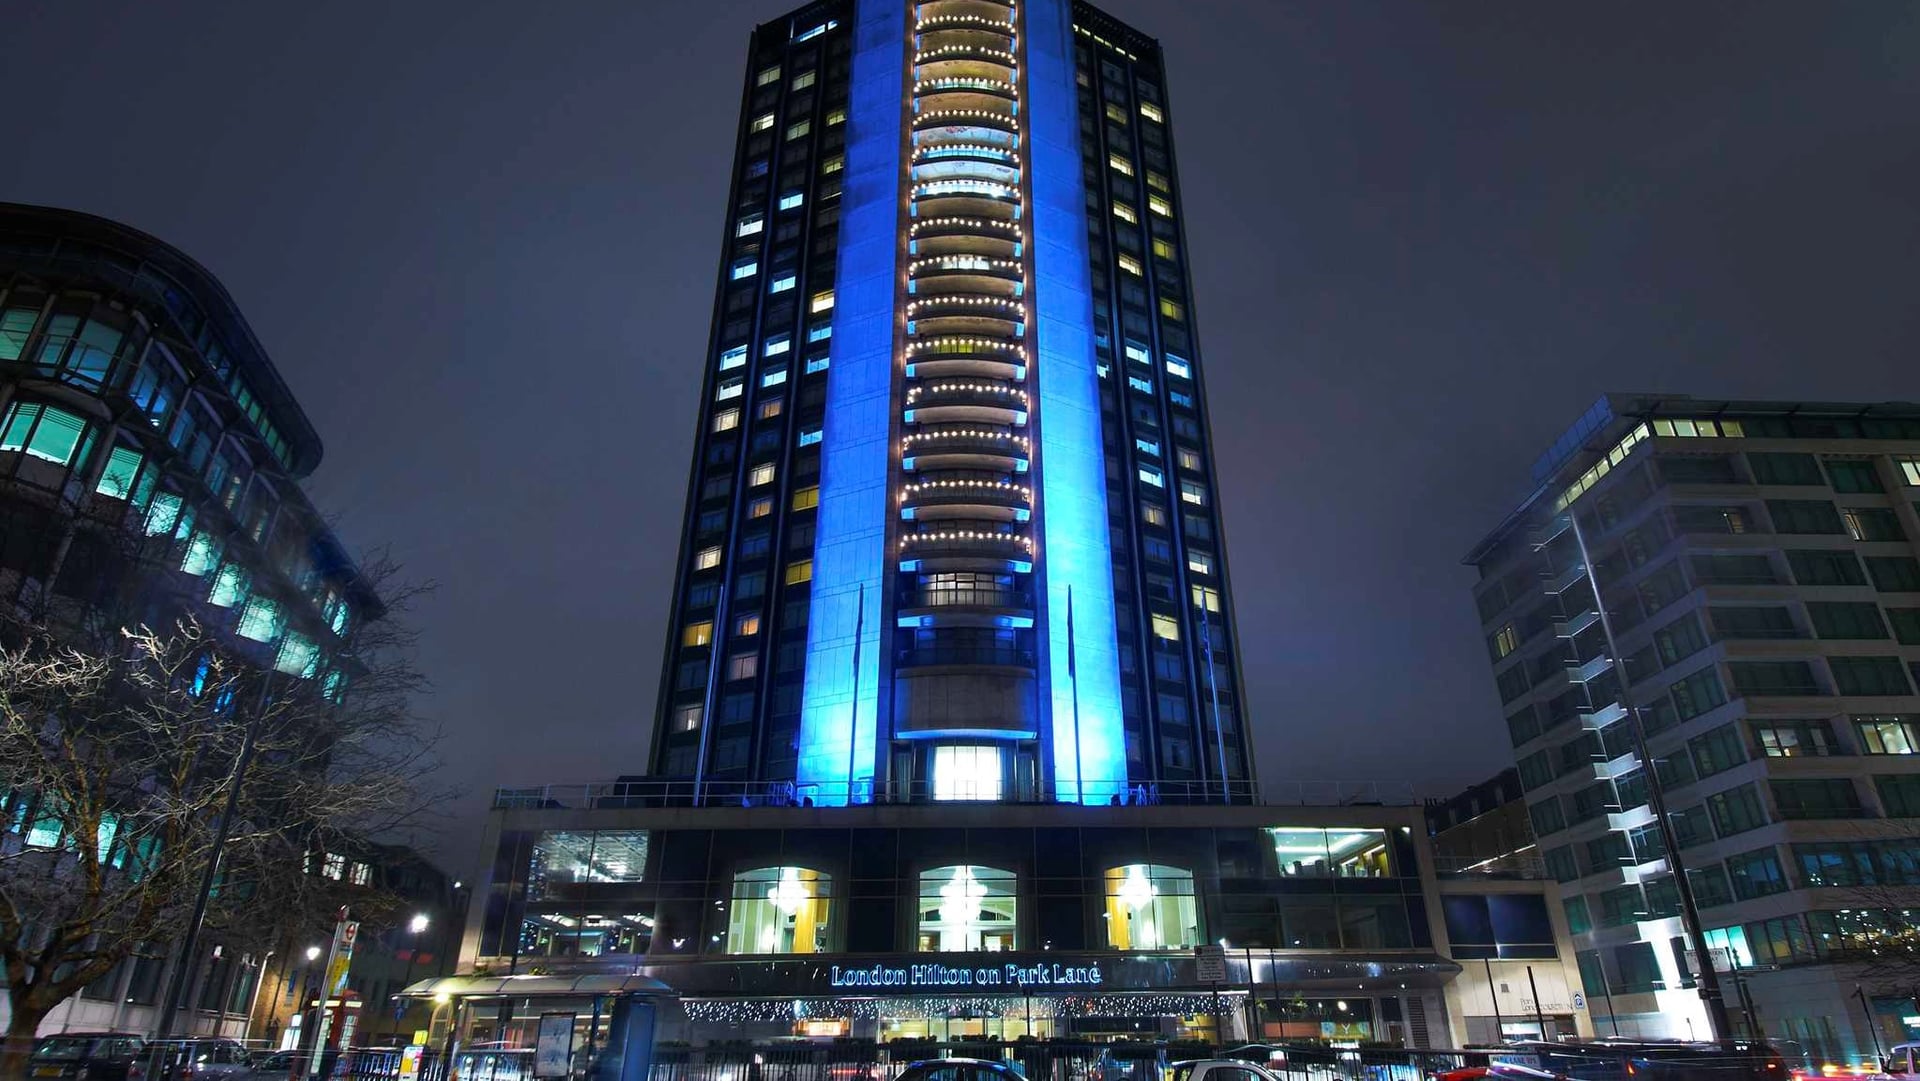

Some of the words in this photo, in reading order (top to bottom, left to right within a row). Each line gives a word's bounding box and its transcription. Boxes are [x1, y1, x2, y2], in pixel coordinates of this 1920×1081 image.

[831, 964, 907, 986] London
[911, 963, 973, 985] Hilton
[975, 968, 1001, 985] on
[1005, 963, 1051, 984] Park
[1053, 963, 1102, 984] Lane
